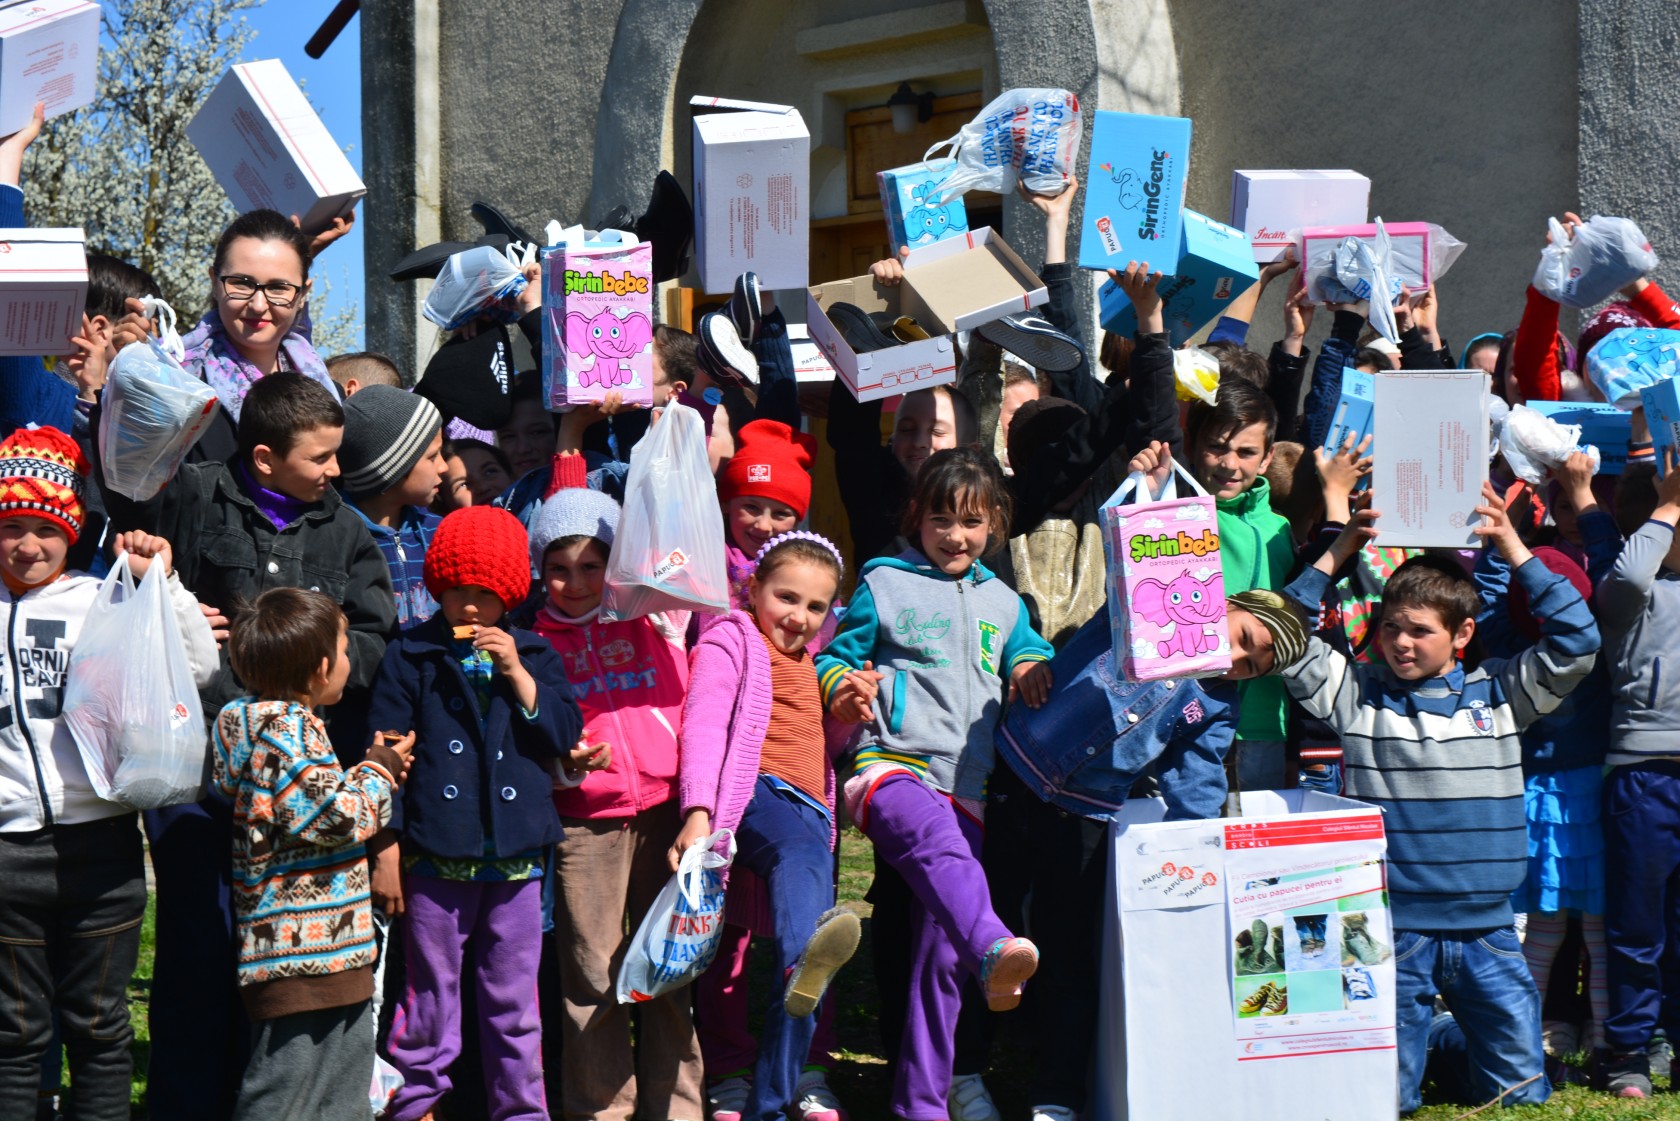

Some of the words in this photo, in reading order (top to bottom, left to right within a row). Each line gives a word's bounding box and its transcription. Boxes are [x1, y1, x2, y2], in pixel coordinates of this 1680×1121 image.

[497, 341, 508, 395] adidas
[1233, 894, 1255, 905] Cutia
[1257, 892, 1267, 901] cu
[1269, 885, 1304, 898] papucei
[1304, 878, 1334, 892] pentru
[1334, 875, 1343, 885] ei
